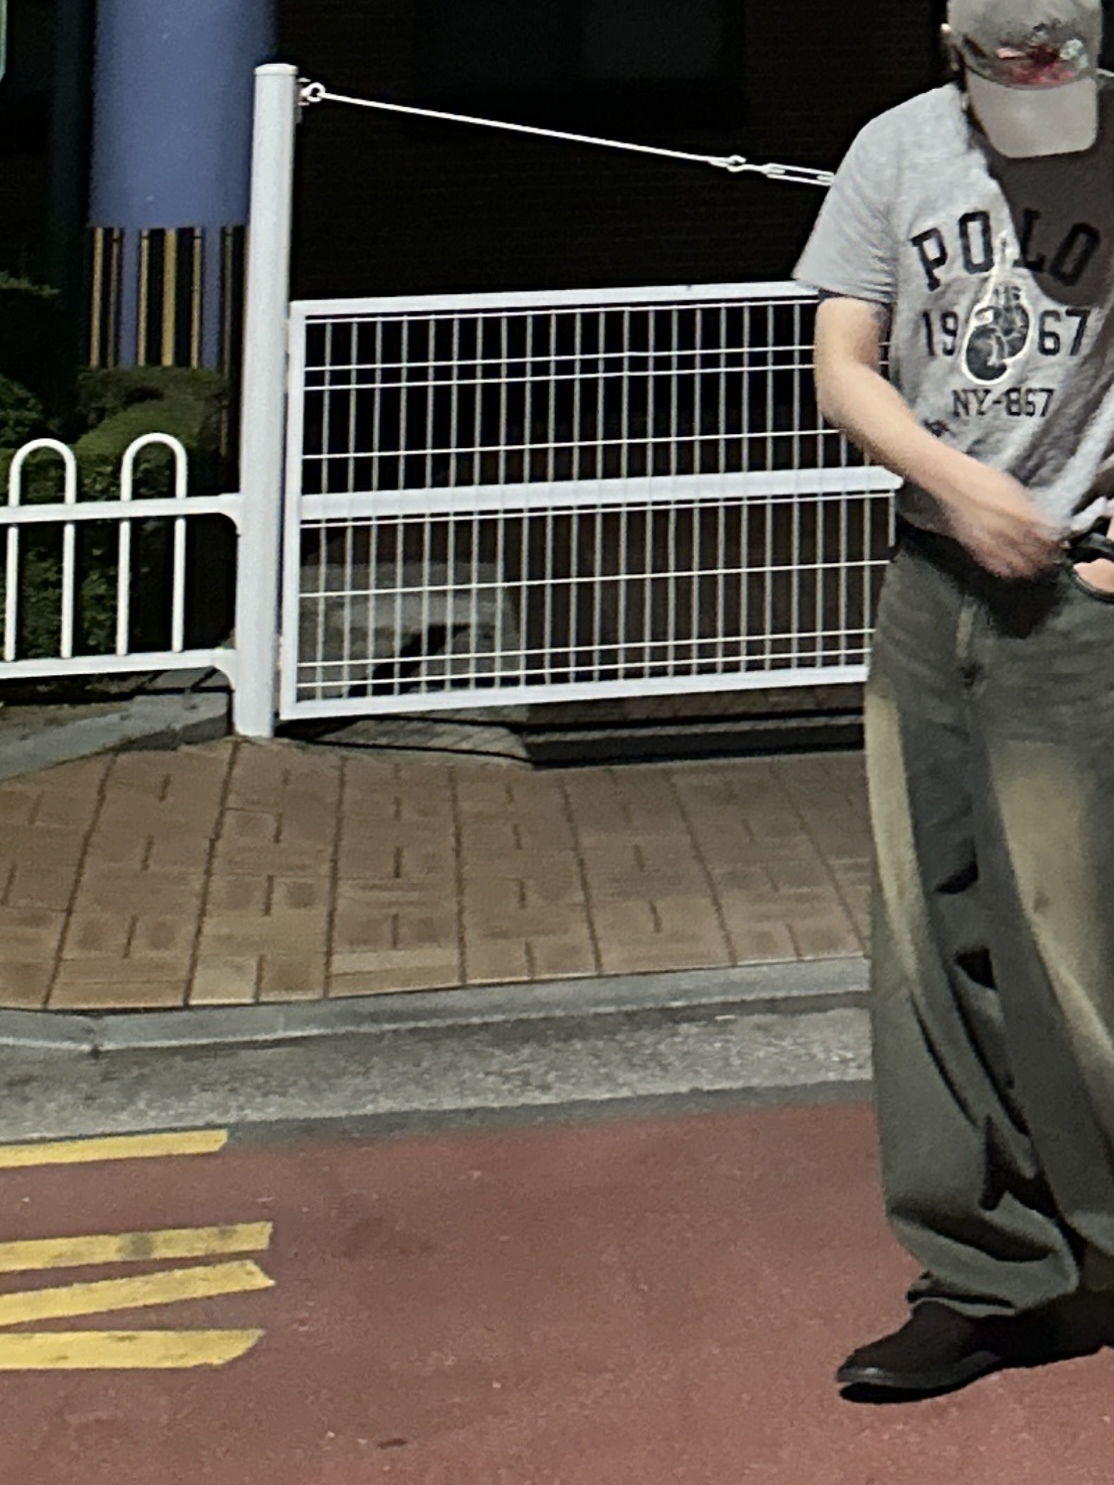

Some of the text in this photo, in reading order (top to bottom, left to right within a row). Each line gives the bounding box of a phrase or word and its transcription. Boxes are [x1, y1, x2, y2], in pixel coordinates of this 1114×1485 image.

[910, 208, 1101, 292] POLO
[921, 308, 1093, 358] 19 67
